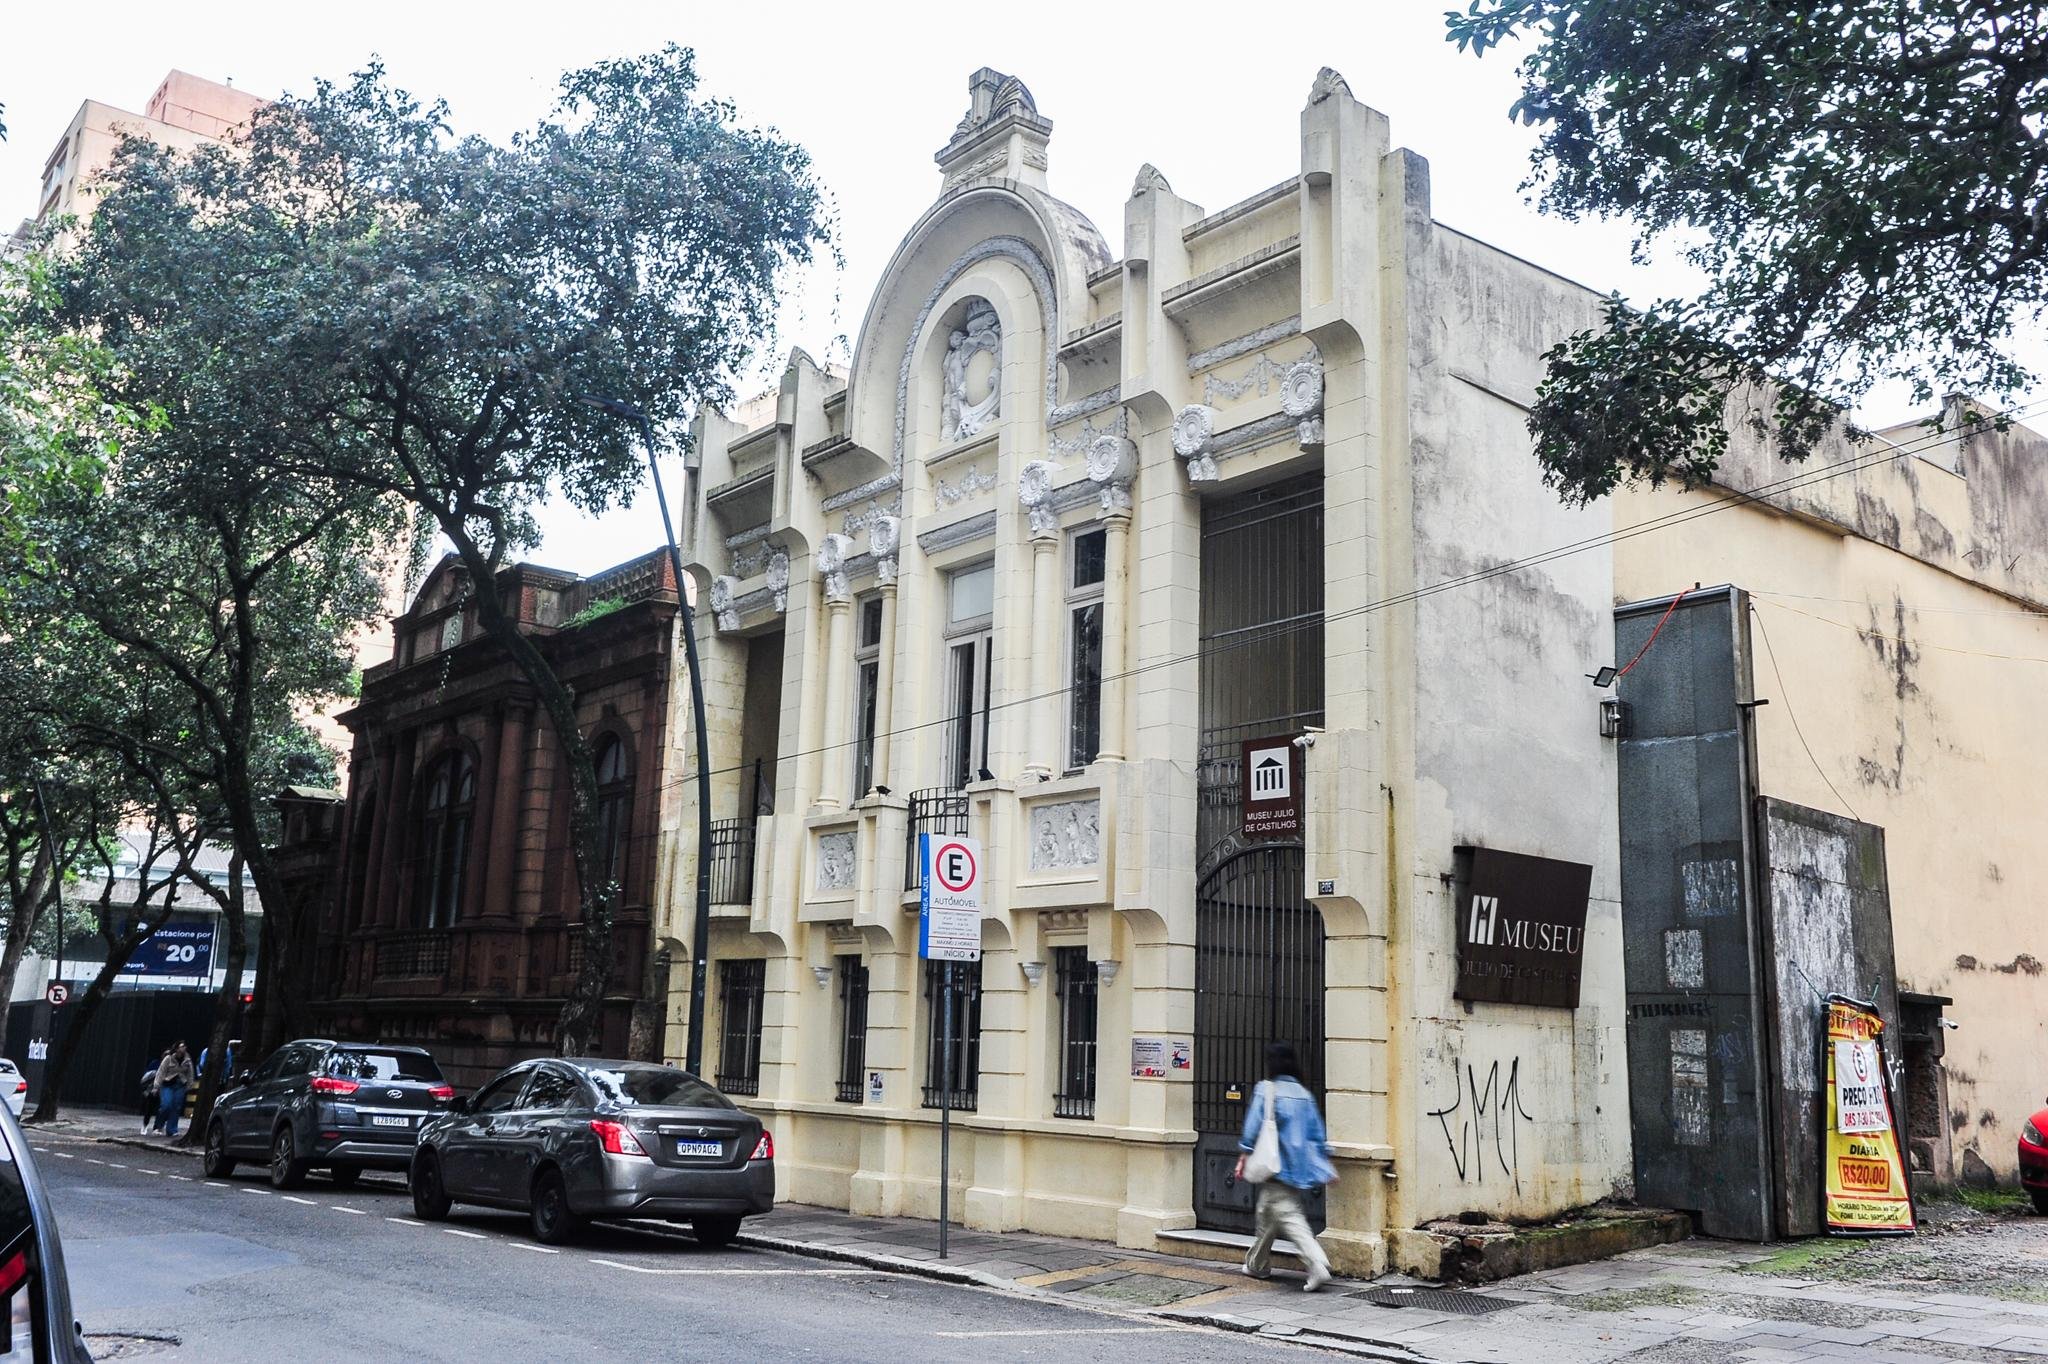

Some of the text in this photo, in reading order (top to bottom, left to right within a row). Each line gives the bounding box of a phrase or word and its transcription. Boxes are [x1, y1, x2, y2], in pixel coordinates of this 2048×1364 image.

[1247, 808, 1295, 821] MUSEU JULIO
[1245, 820, 1297, 833] DE CASTILHOS
[949, 853, 963, 881] E
[196, 930, 211, 940] por
[1500, 918, 1582, 954] MUSEU
[1842, 1086, 1867, 1108] PREÇO
